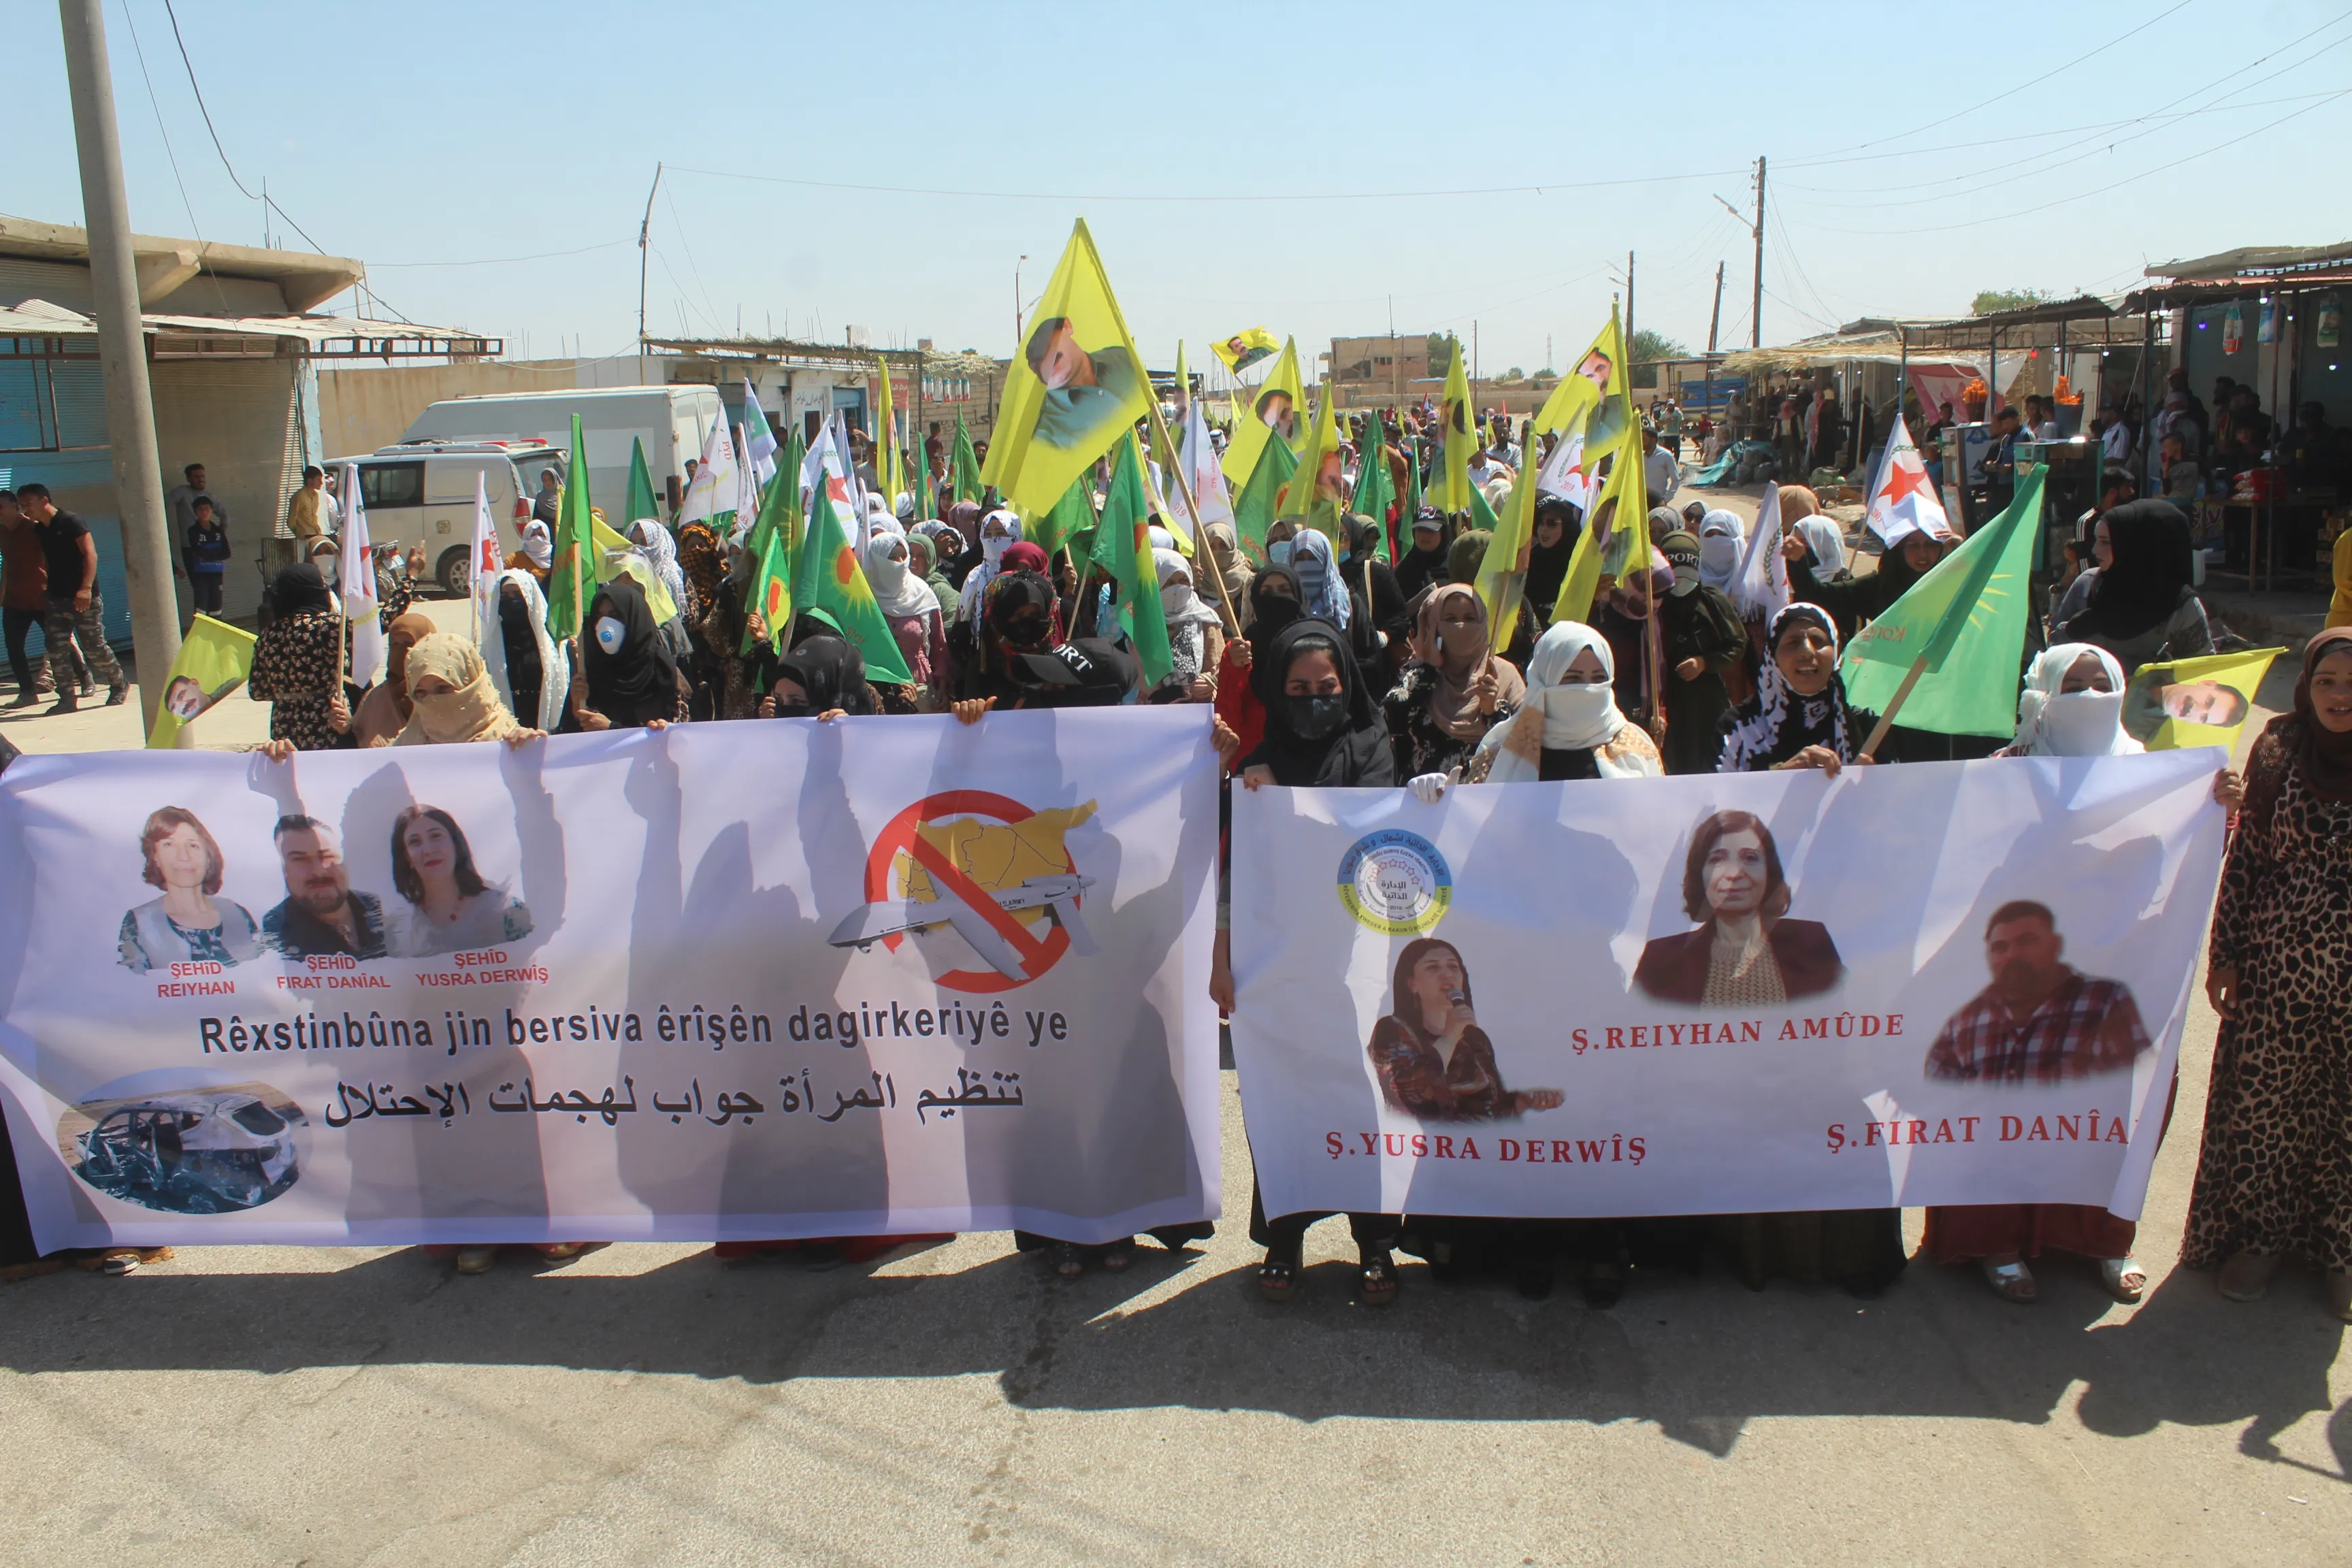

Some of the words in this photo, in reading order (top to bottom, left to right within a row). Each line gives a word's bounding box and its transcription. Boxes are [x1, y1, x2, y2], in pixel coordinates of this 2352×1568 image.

[722, 440, 732, 460] PYD
[1561, 480, 1575, 493] 2019
[1173, 502, 1187, 517] 019
[1537, 494, 1556, 508] SPO
[1242, 534, 1266, 561] Kong
[1665, 552, 1700, 567] PORT
[845, 625, 867, 645] Star
[1053, 643, 1093, 672] ORT
[1381, 880, 1407, 891] الإدارة
[1382, 891, 1408, 901] الذاتية
[307, 952, 357, 973] ŞEHÎD
[454, 949, 508, 969] ŞEHÎD
[276, 976, 322, 990] FIRAT
[327, 973, 391, 990] DANÎAL
[415, 972, 477, 987] YUSRA
[479, 964, 550, 985] DERWÎŞ
[158, 981, 235, 998] REIYHAN
[200, 1011, 434, 1054] Rêxstinbûna
[446, 1011, 491, 1056] jin
[506, 1005, 643, 1046] bersiva
[658, 1005, 772, 1051] êrîşên
[789, 1000, 1011, 1049] dagirkeriyê
[1026, 1009, 1068, 1048] ye
[1572, 1021, 1762, 1056] Ş.REIYHAN
[1778, 1011, 1904, 1041] AMÛDE
[325, 1081, 471, 1128] الإحتلال
[488, 1075, 638, 1126] لهجمات
[652, 1077, 765, 1126] جواب
[778, 1067, 896, 1124] المرأة
[917, 1067, 1024, 1126] تنظيم
[1827, 1117, 1981, 1155] Ş.FIRAT
[1999, 1109, 2139, 1145] DANÎA
[1326, 1132, 1481, 1160] Ş.YUSRA
[1499, 1134, 1646, 1166] DERWÎŞ
